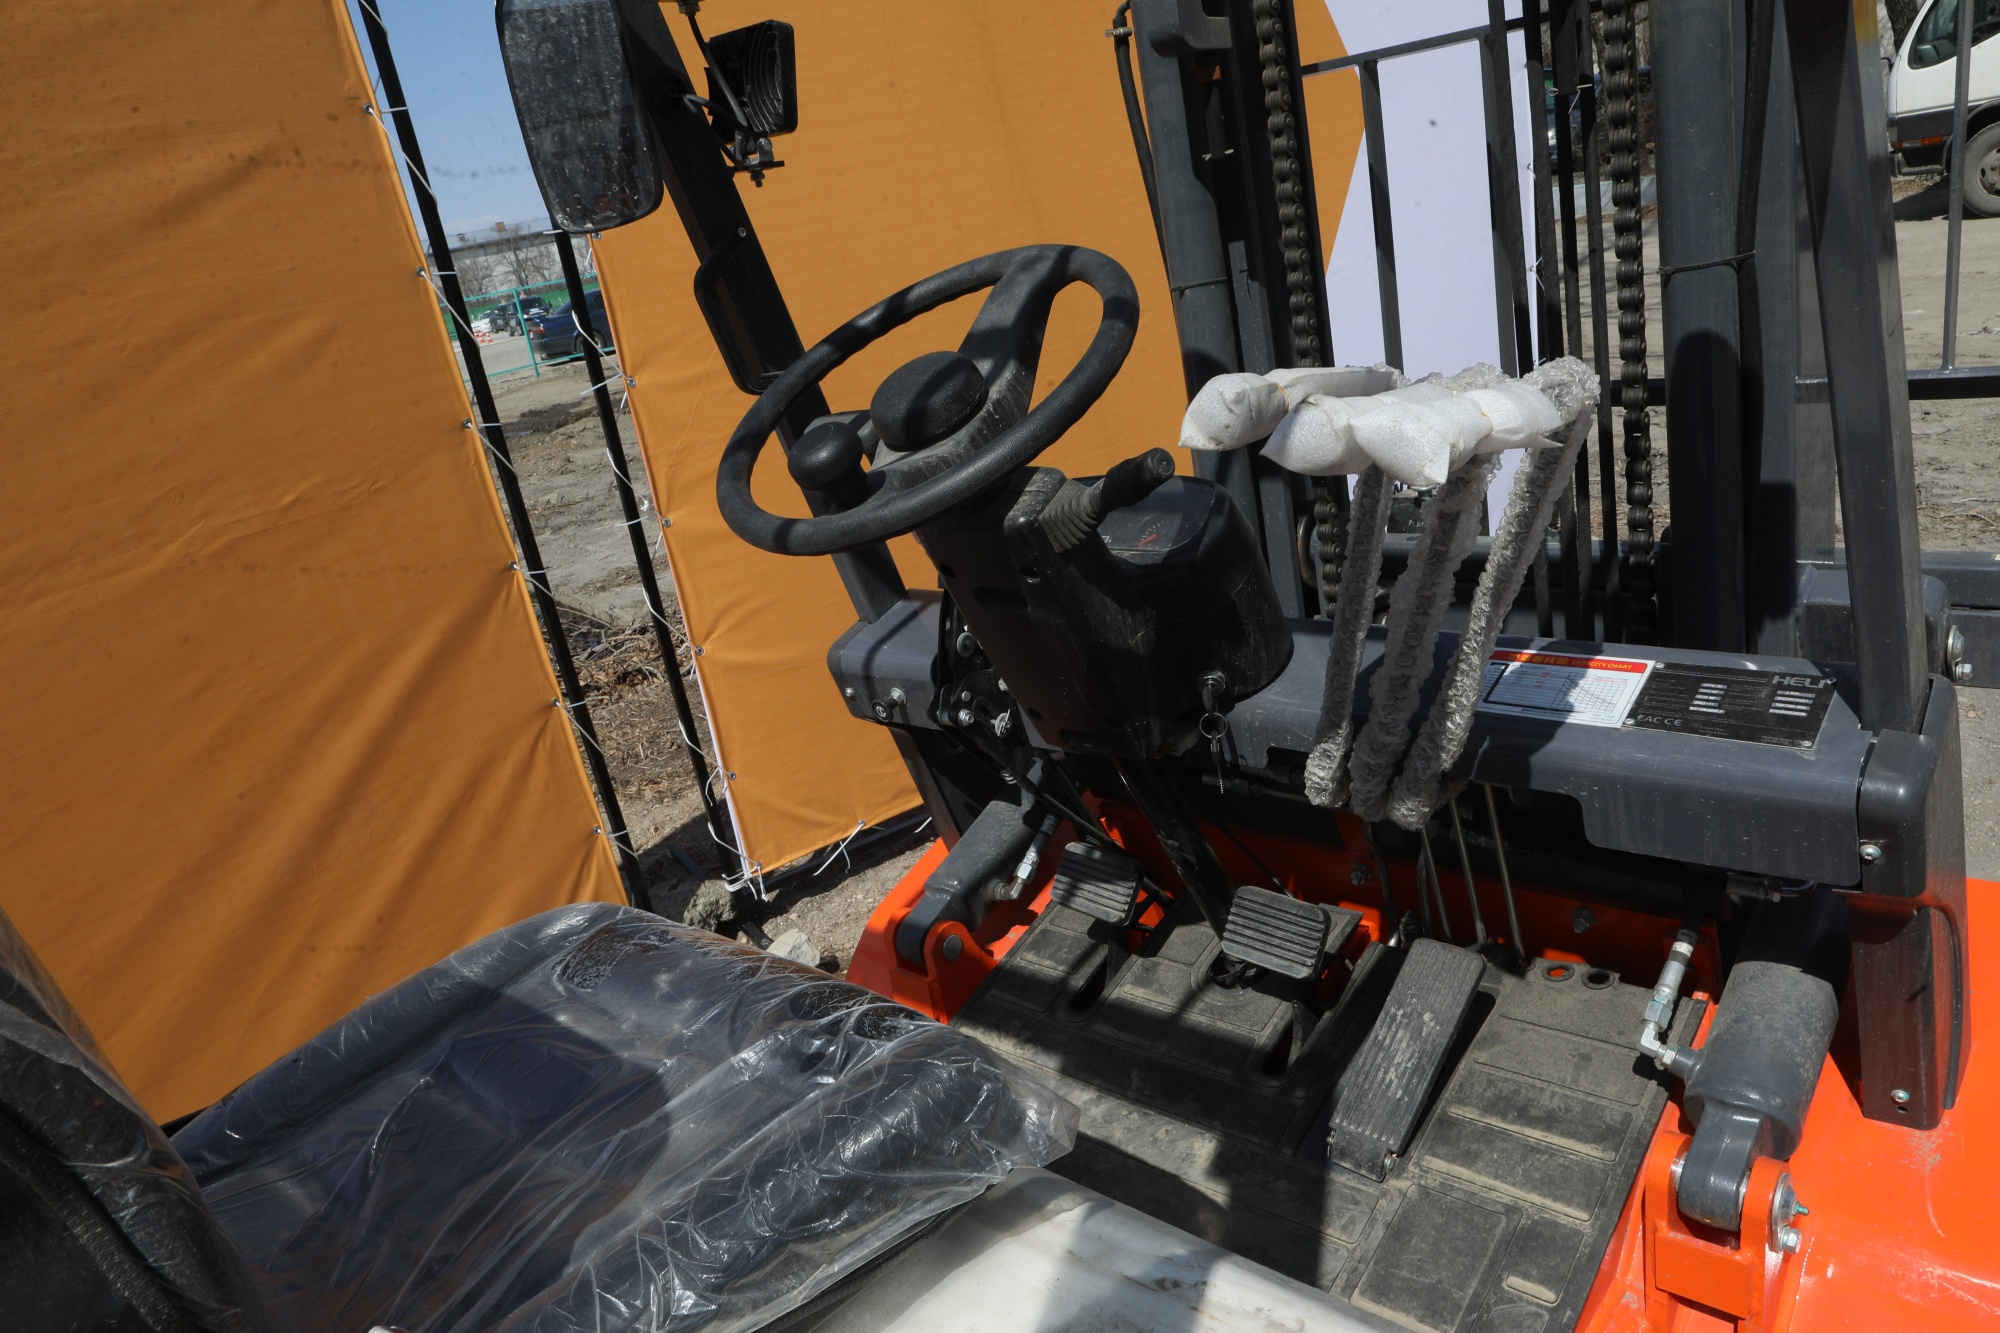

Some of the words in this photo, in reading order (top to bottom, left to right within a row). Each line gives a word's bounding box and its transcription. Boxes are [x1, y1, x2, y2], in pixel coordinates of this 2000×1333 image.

[1571, 660, 1607, 669] CAPACITY
[1772, 675, 1826, 689] HELI
[1636, 714, 1663, 724] EAC
[1664, 718, 1684, 726] CE
